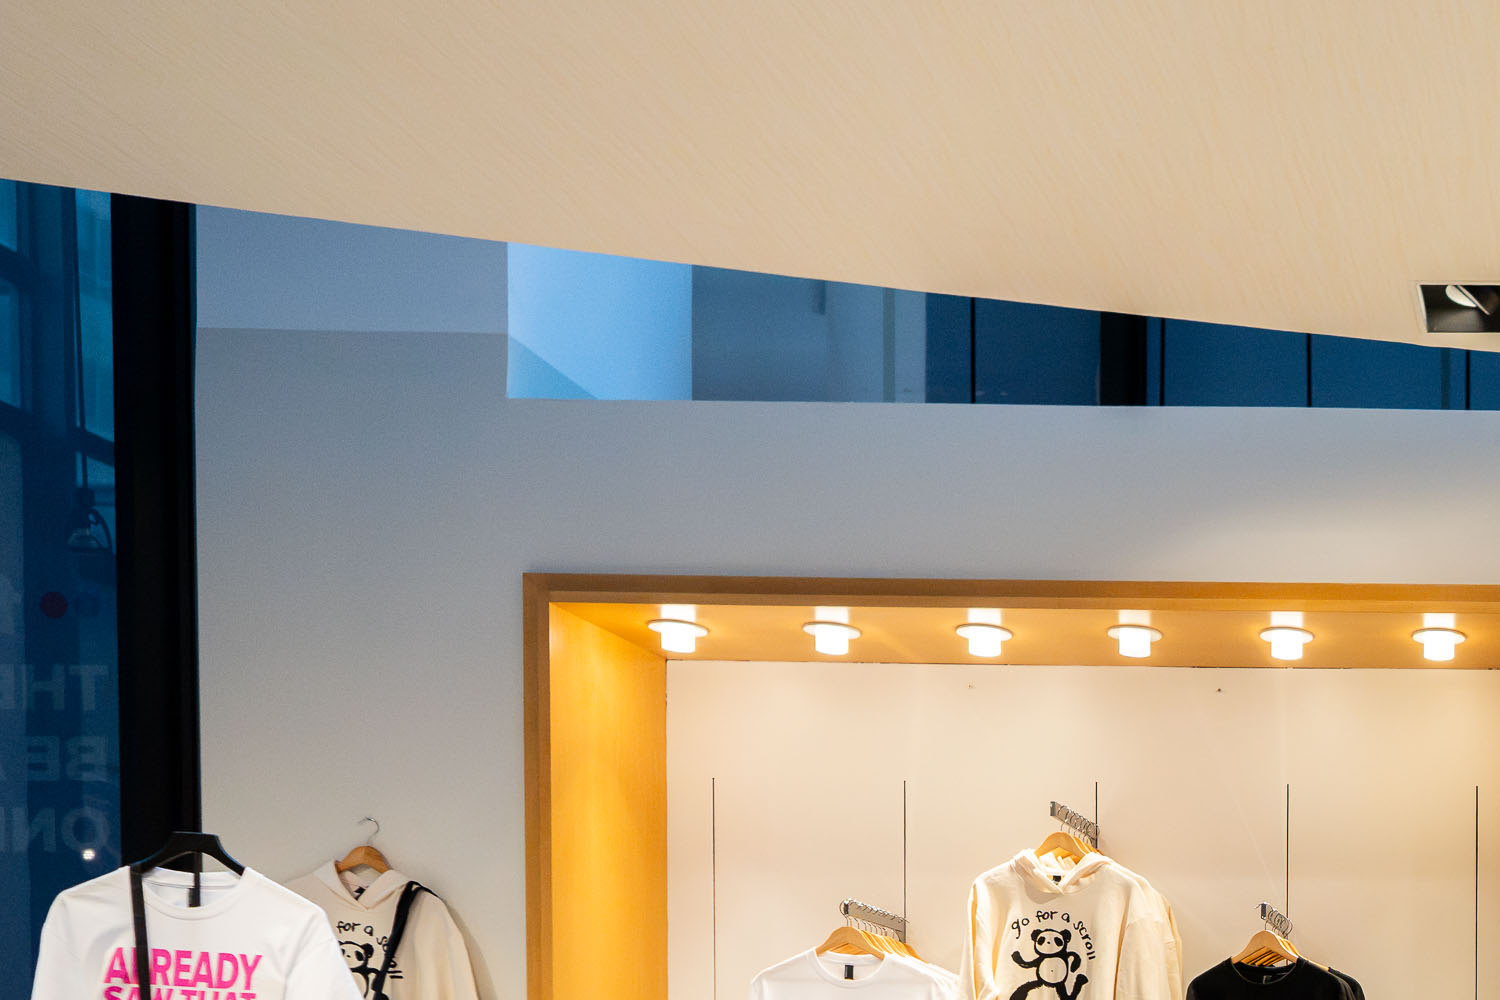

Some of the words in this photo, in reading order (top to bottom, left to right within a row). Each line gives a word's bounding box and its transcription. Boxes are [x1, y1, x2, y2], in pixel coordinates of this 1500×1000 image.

[336, 920, 362, 934] for
[363, 925, 374, 937] a
[1011, 918, 1030, 940] go
[1035, 910, 1059, 923] for
[1061, 912, 1071, 923] a
[1073, 920, 1096, 961] scroll
